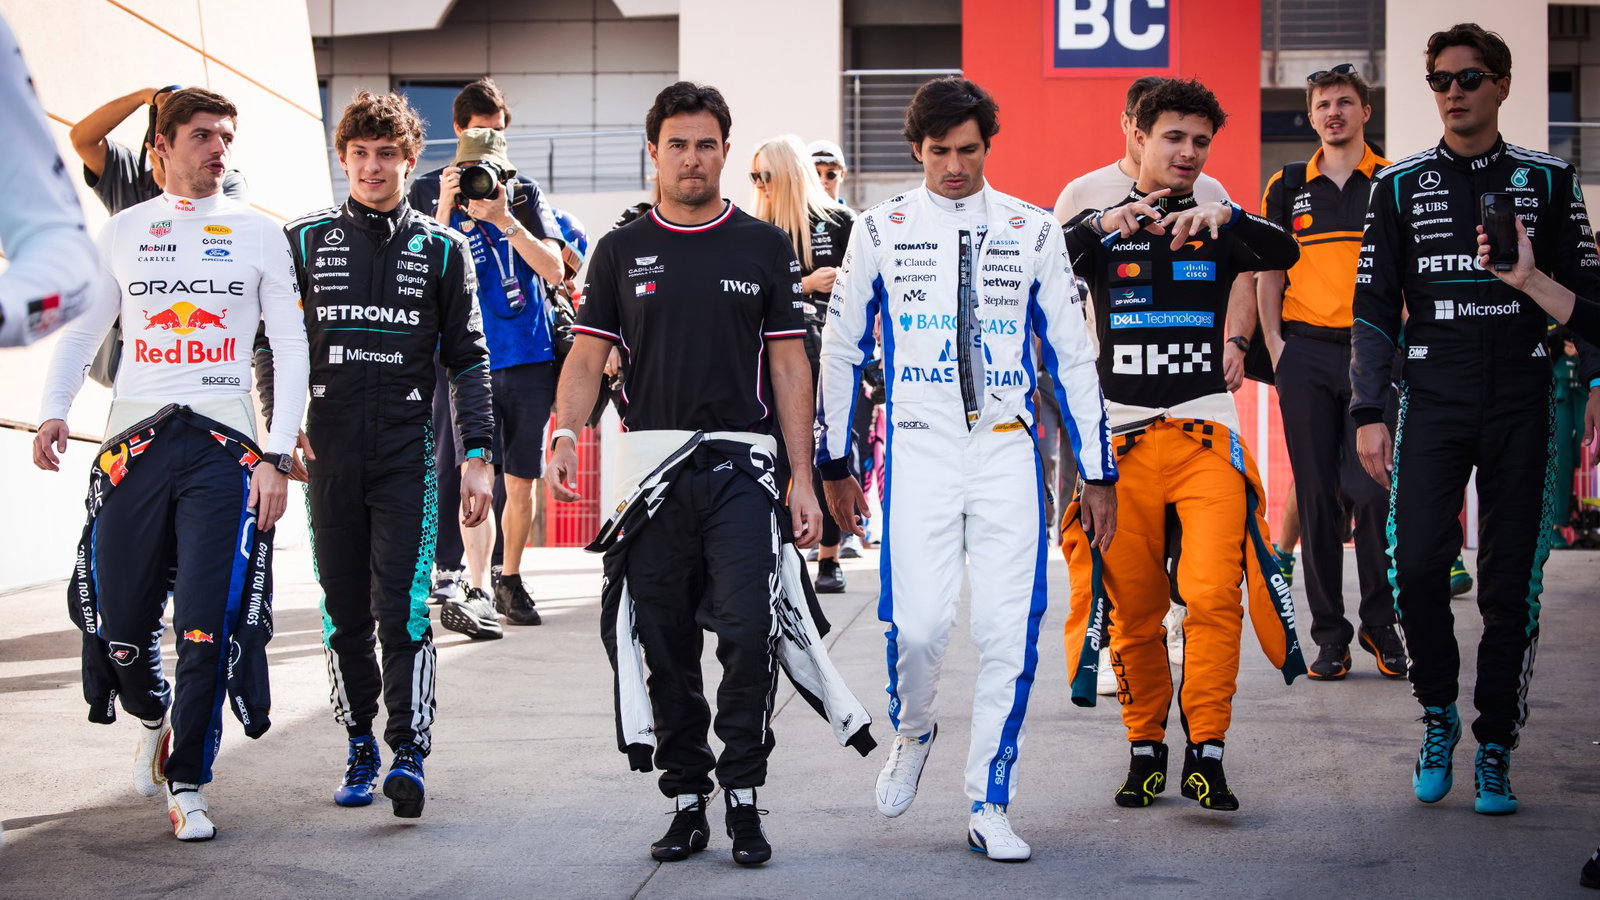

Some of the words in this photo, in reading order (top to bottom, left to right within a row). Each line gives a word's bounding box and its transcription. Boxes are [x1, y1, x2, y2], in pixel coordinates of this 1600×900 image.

[1059, 0, 1166, 50] BC
[1425, 201, 1449, 213] UBS
[1514, 197, 1539, 208] EOS
[1413, 217, 1453, 228] CROWDSTRIKE
[865, 215, 882, 248] sparco
[1034, 221, 1051, 252] sparco
[1420, 231, 1454, 241] Snapdragon
[139, 244, 166, 252] Mobil
[894, 241, 938, 252] KOMATSU
[1112, 241, 1150, 253] Android
[327, 257, 348, 267] UBS
[397, 260, 429, 273] INEOS
[904, 257, 937, 268] Claude
[628, 265, 665, 275] CADILLAC
[128, 280, 245, 296] ORACLE
[720, 280, 751, 294] TWG
[983, 277, 1022, 290] betway
[398, 287, 424, 298] HPE
[984, 294, 1020, 308] Stephens
[1123, 297, 1147, 305] WORLD
[316, 305, 420, 326] PETRONAS
[1458, 300, 1520, 317] Microsoft
[1113, 313, 1143, 326] DELL
[1144, 312, 1212, 327] Technologies
[135, 339, 181, 364] Red
[187, 338, 236, 363] Bull
[346, 348, 404, 365] Microsoft
[1409, 346, 1428, 359] OMP
[1112, 343, 1212, 375] OKX
[201, 376, 240, 386] sparco
[897, 420, 930, 430] sparco
[255, 542, 269, 570] GIVES
[252, 571, 266, 593] YOU
[78, 582, 91, 605] YOU
[1269, 573, 1297, 630] allwyn
[246, 592, 263, 626] WINGS
[83, 606, 96, 634] GIVES
[994, 746, 1014, 787] sparco
